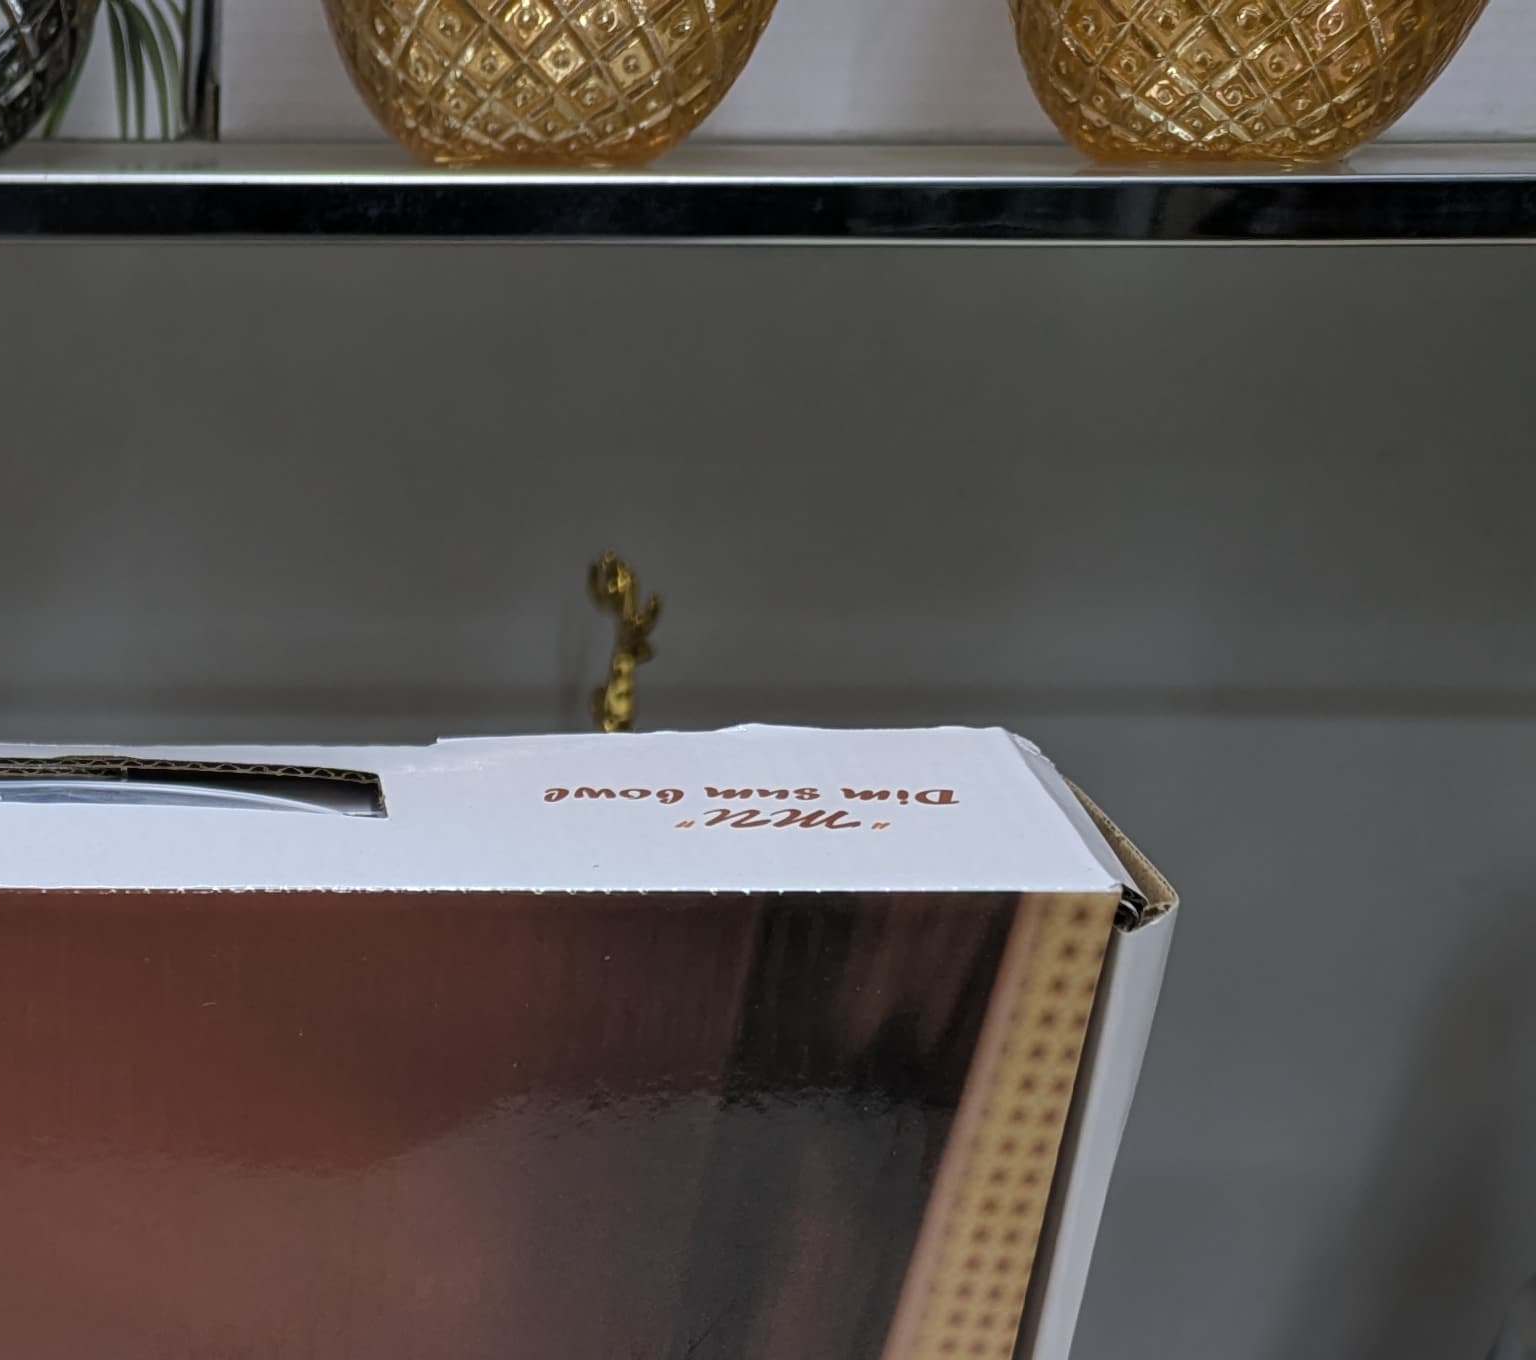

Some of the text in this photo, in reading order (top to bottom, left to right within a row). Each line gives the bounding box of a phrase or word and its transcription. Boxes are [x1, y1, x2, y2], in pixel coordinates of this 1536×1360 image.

[543, 785, 961, 805] Dim sum bowl
